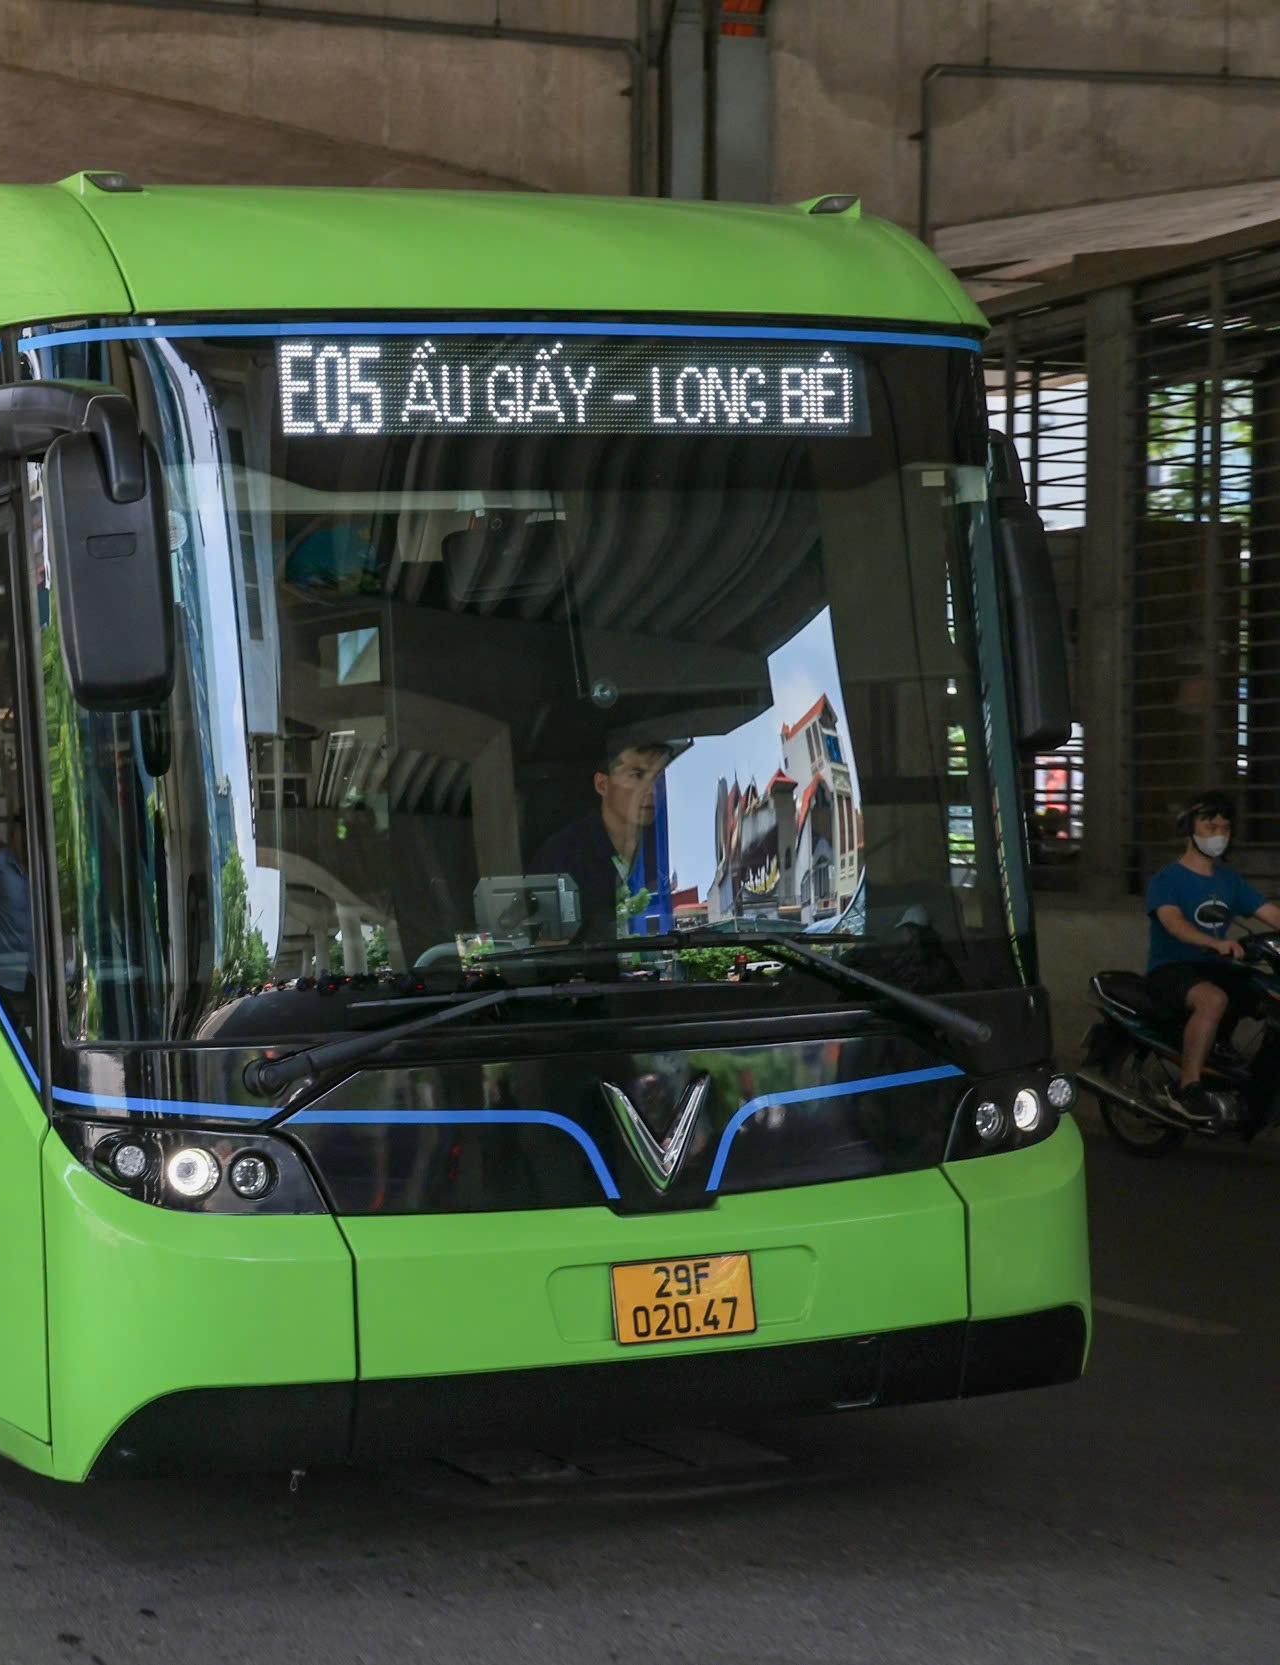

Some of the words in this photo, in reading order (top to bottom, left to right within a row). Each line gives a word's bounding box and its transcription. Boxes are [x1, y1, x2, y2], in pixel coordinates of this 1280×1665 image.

[281, 345, 383, 434] E05
[487, 342, 596, 423] GIẤY
[652, 367, 766, 424] LONG
[781, 351, 853, 424] BIÊ
[653, 1261, 710, 1298] 29F
[632, 1296, 738, 1338] 020.47
